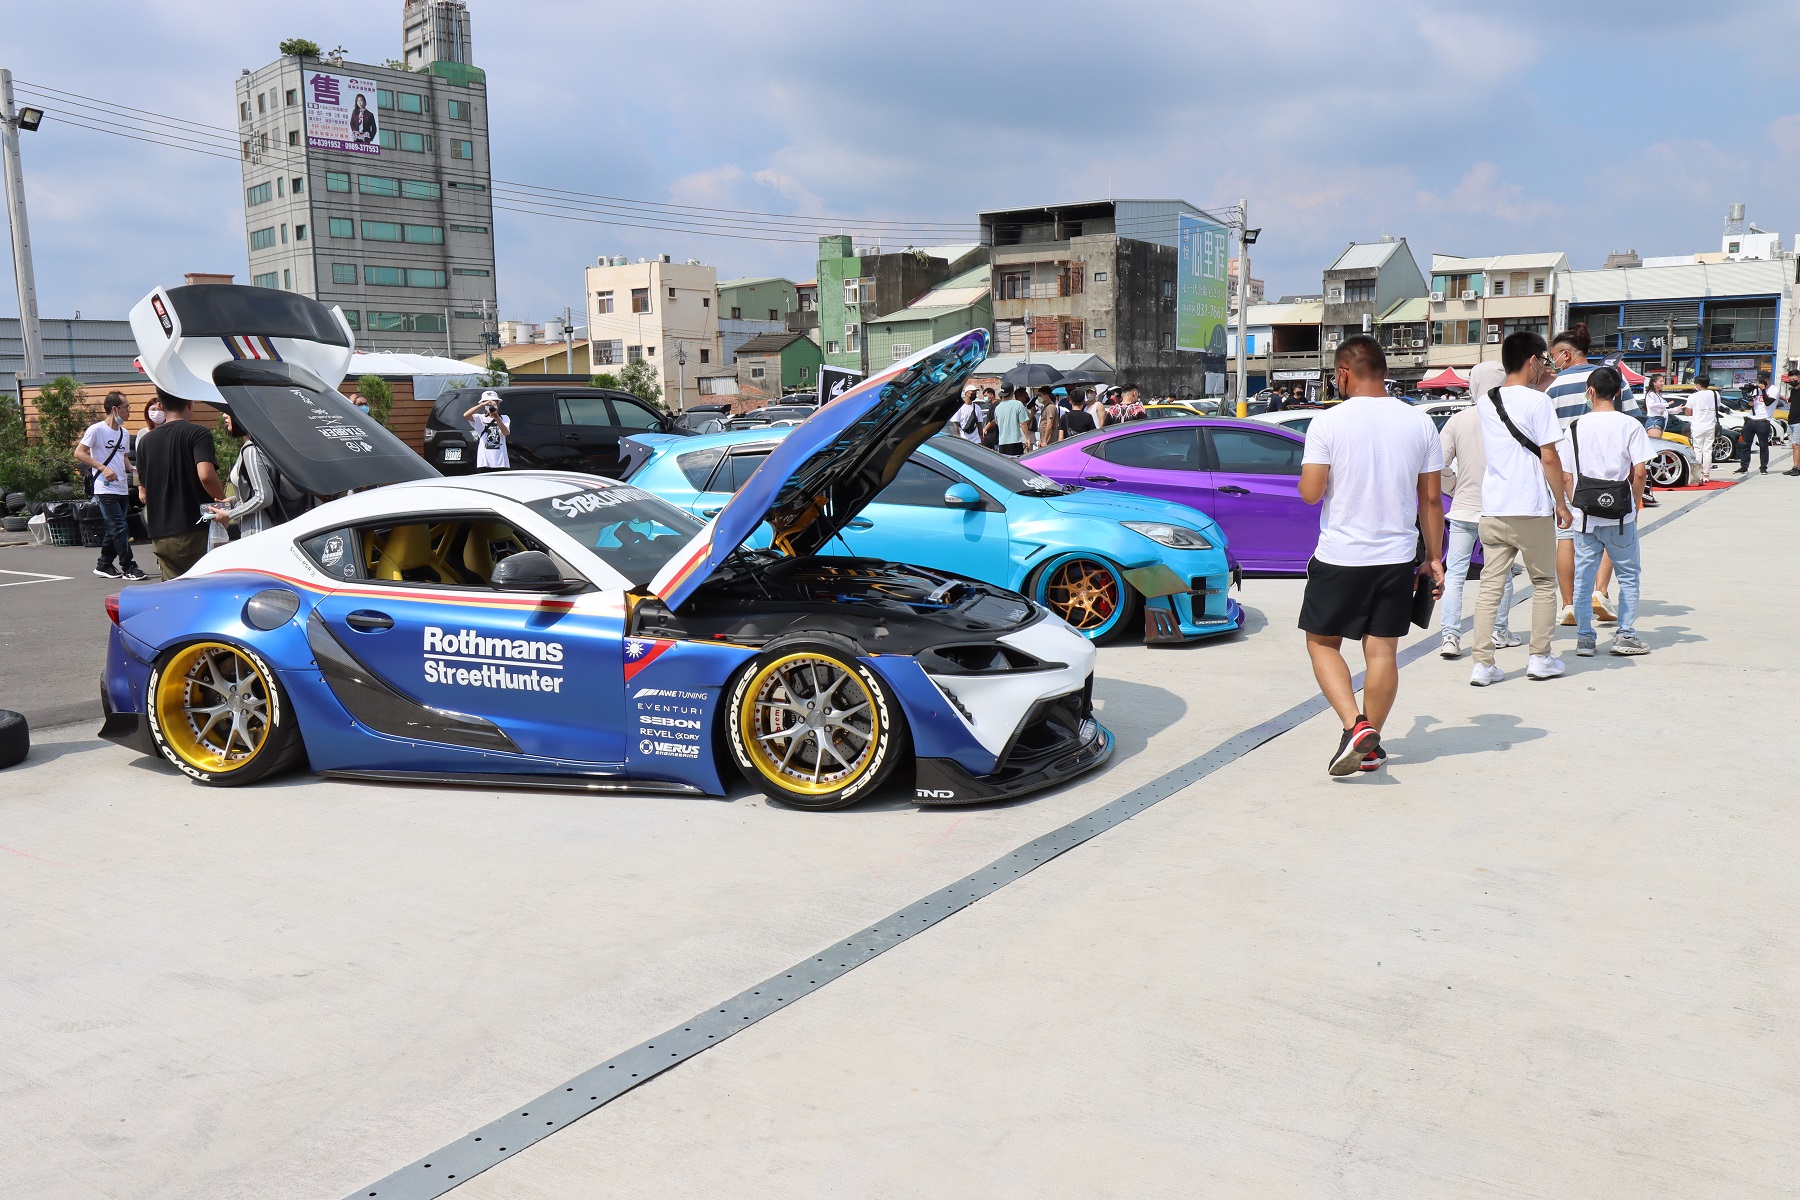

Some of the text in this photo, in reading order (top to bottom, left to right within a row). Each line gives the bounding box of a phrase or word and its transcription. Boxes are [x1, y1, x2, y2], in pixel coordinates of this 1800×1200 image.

[309, 73, 341, 106] 售
[423, 626, 564, 662] Rothmans
[424, 660, 564, 693] StreetHunter
[637, 702, 702, 715] EVENTURI
[658, 689, 708, 700] AWE TUNING
[147, 668, 211, 782] TOYO TIRES
[639, 715, 701, 730] SEBON
[729, 661, 758, 768] PROXES
[653, 741, 700, 755] VERUS
[840, 665, 890, 800] TOYO TIRES
